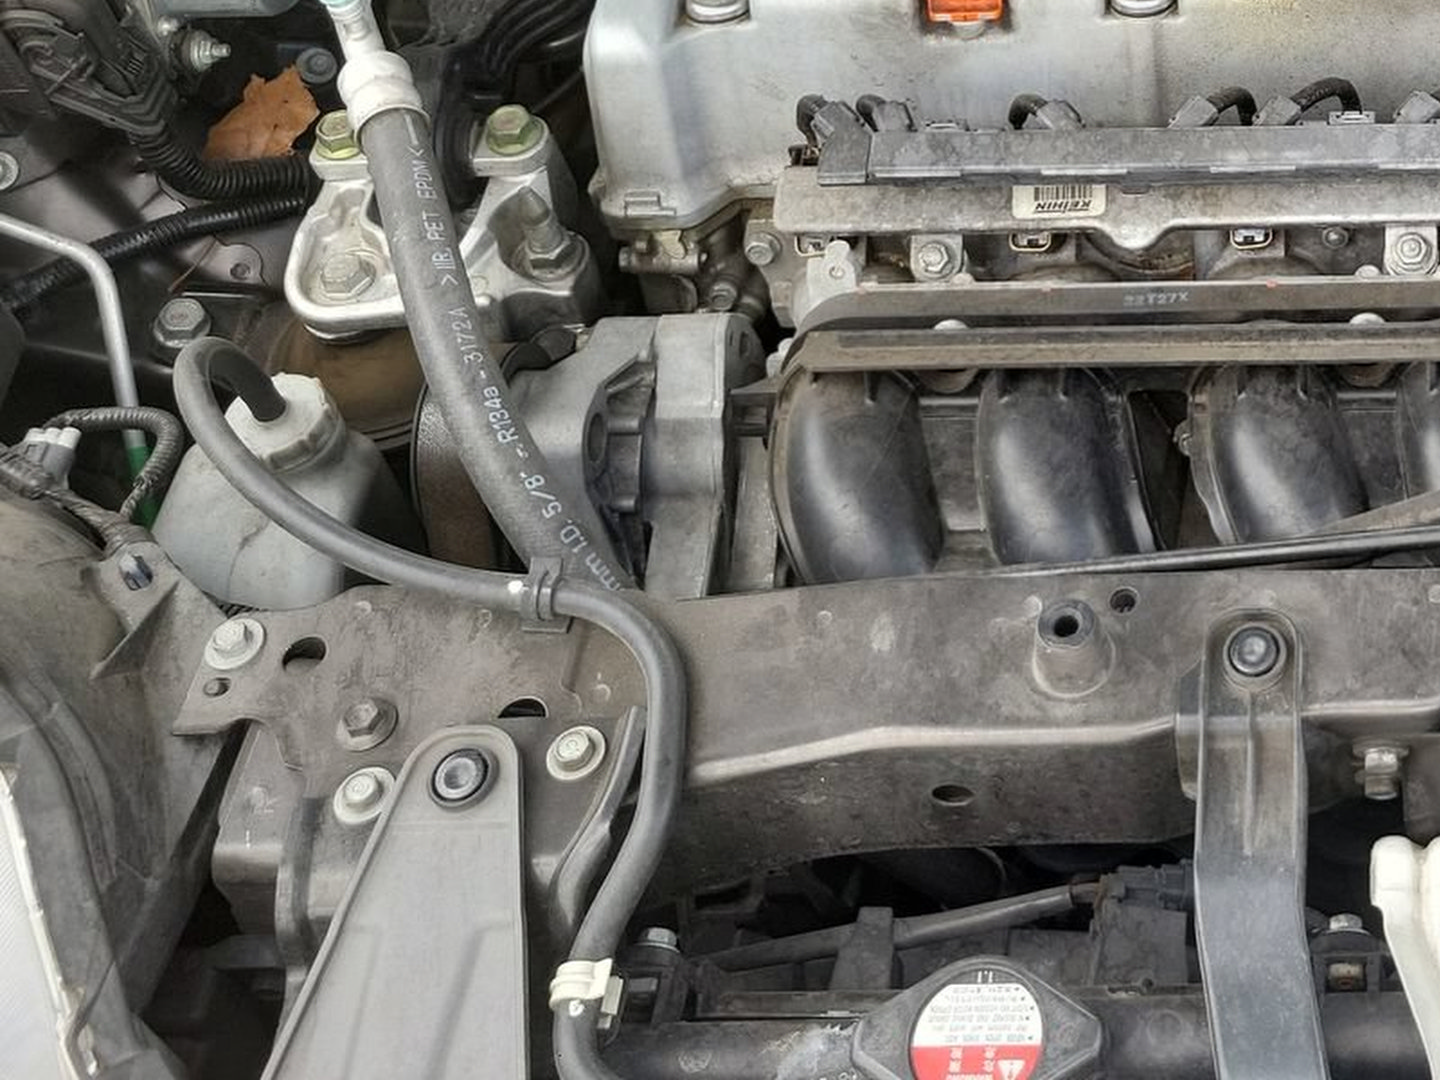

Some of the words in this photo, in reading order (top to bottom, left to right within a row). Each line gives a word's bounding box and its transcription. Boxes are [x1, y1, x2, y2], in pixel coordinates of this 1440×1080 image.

[422, 210, 447, 242] PET
[1035, 200, 1092, 213] KEIHIN
[448, 306, 484, 364] 3172A
[483, 386, 519, 444] R134a
